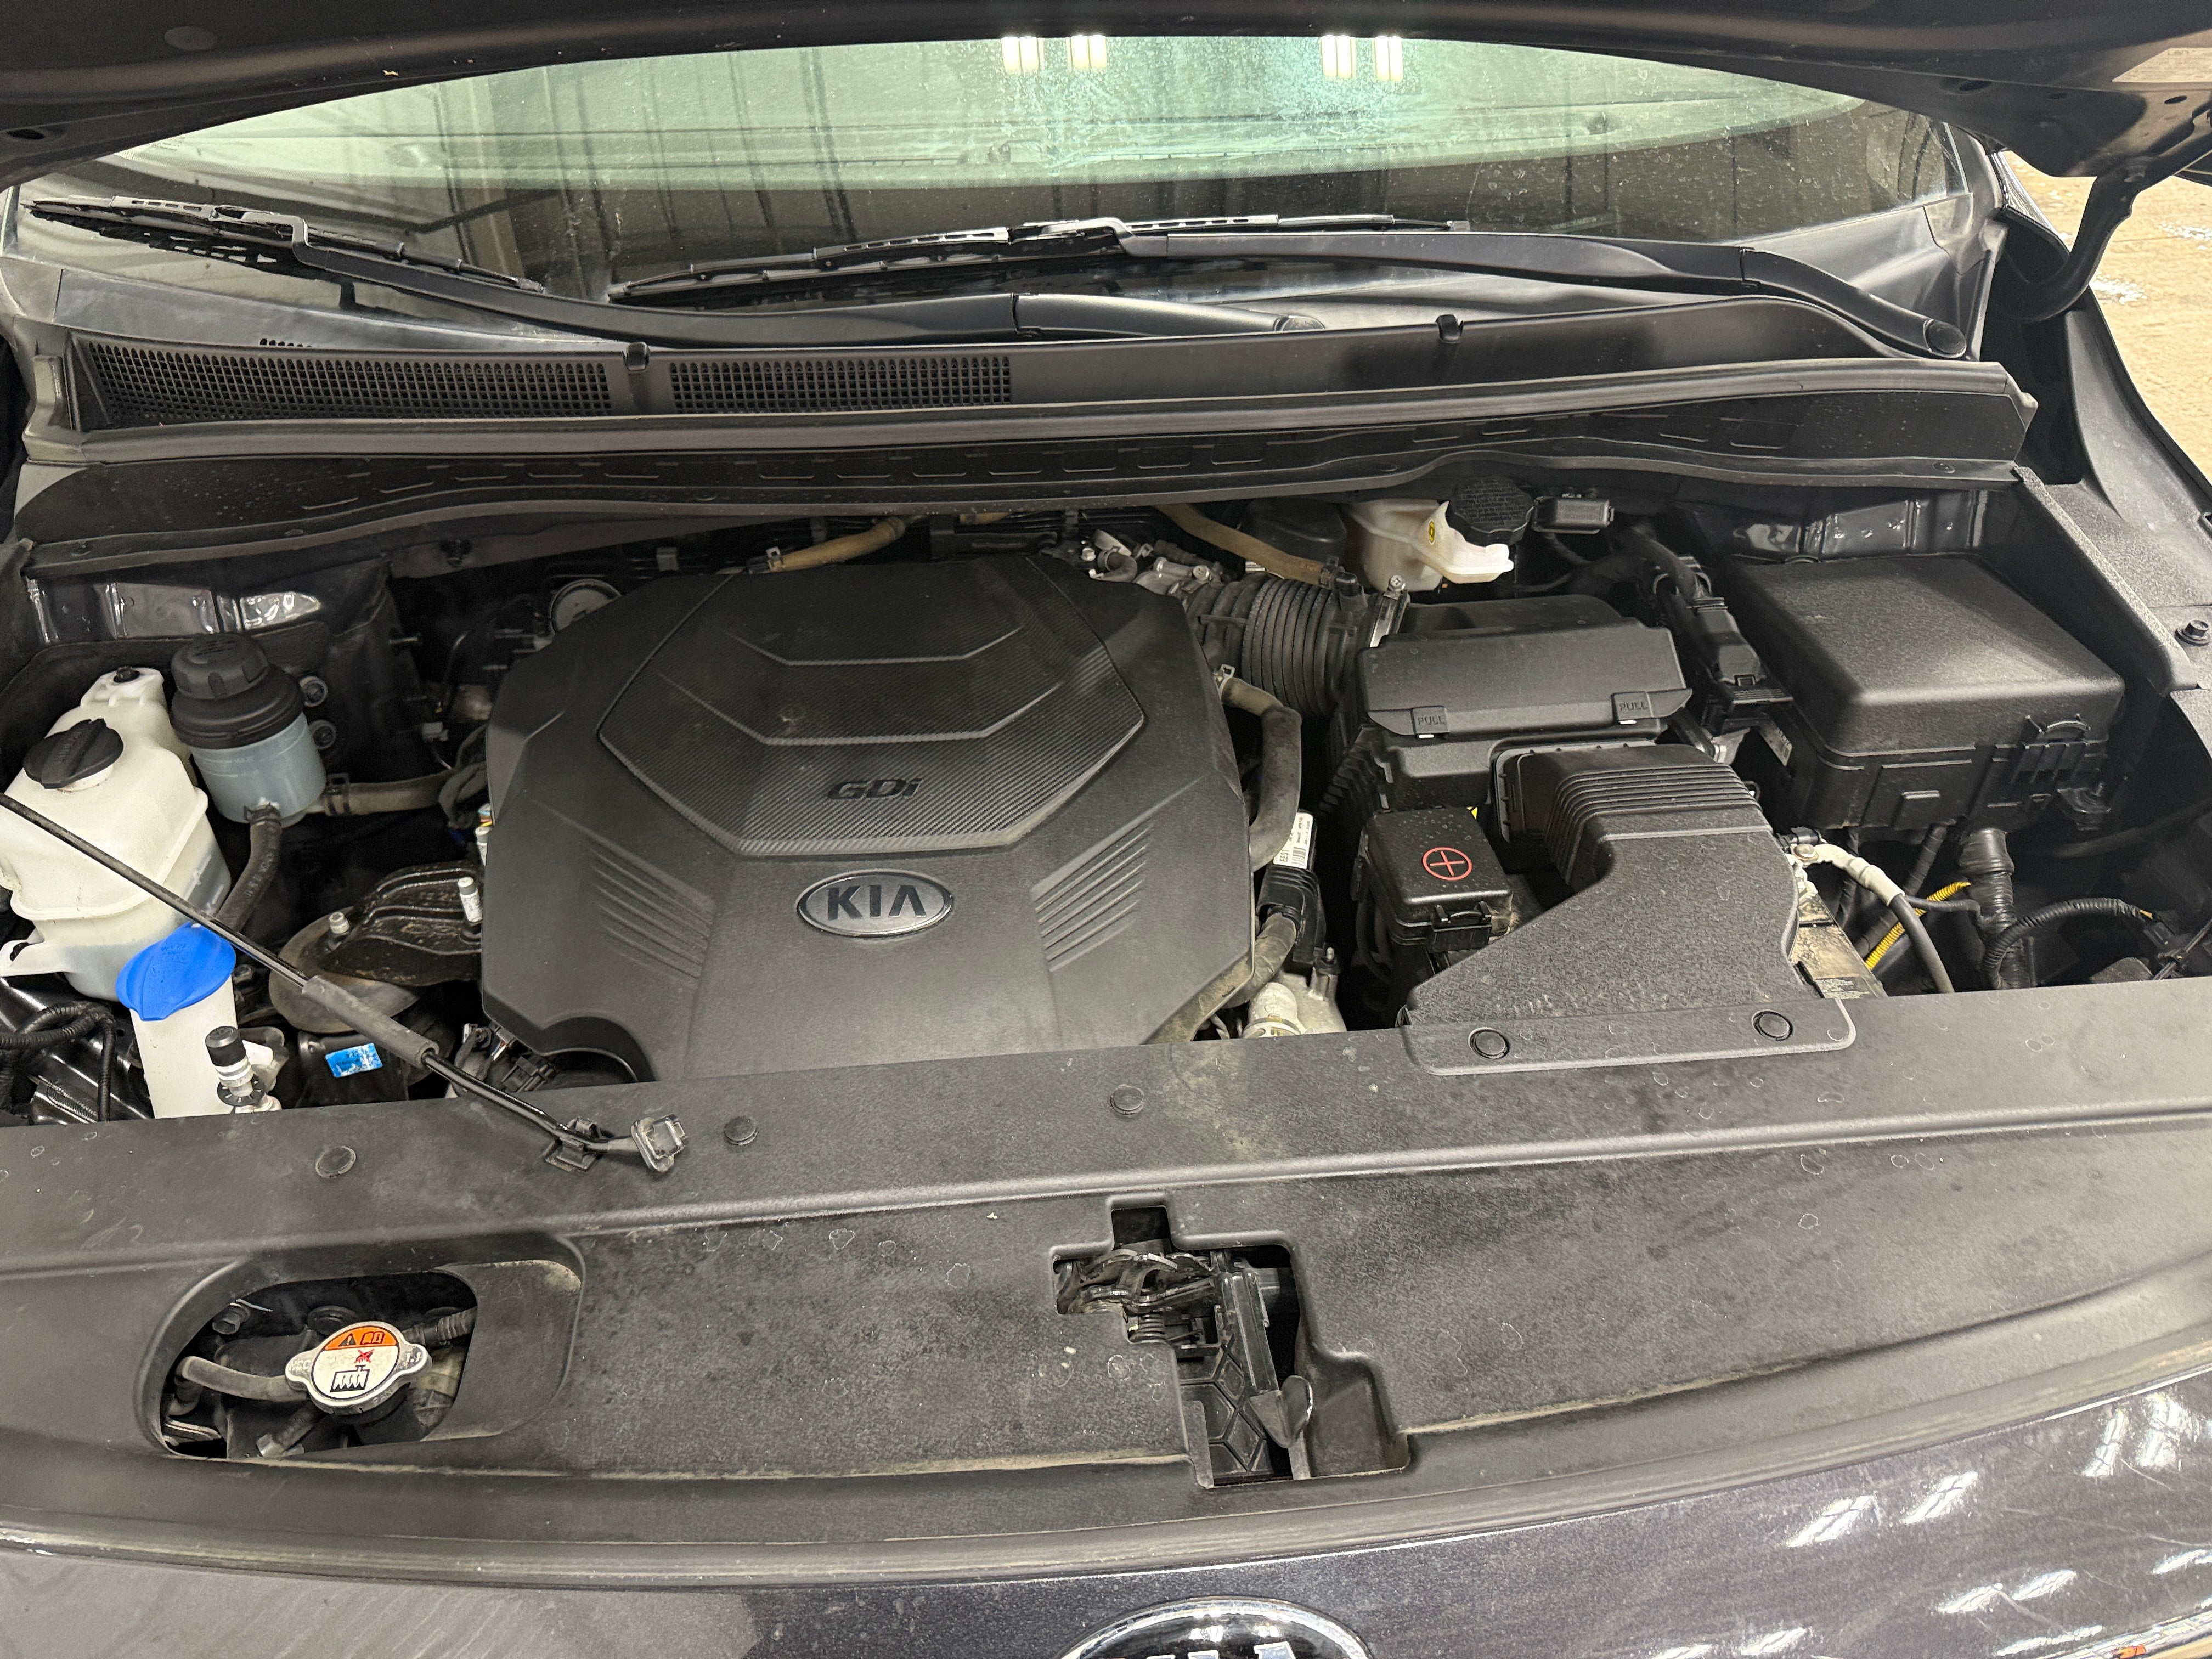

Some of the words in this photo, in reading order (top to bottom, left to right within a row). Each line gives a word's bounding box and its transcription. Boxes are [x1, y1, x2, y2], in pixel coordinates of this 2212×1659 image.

[1618, 702, 1648, 712] PULL
[1417, 715, 1446, 725] PULL
[827, 884, 927, 921] KIA
